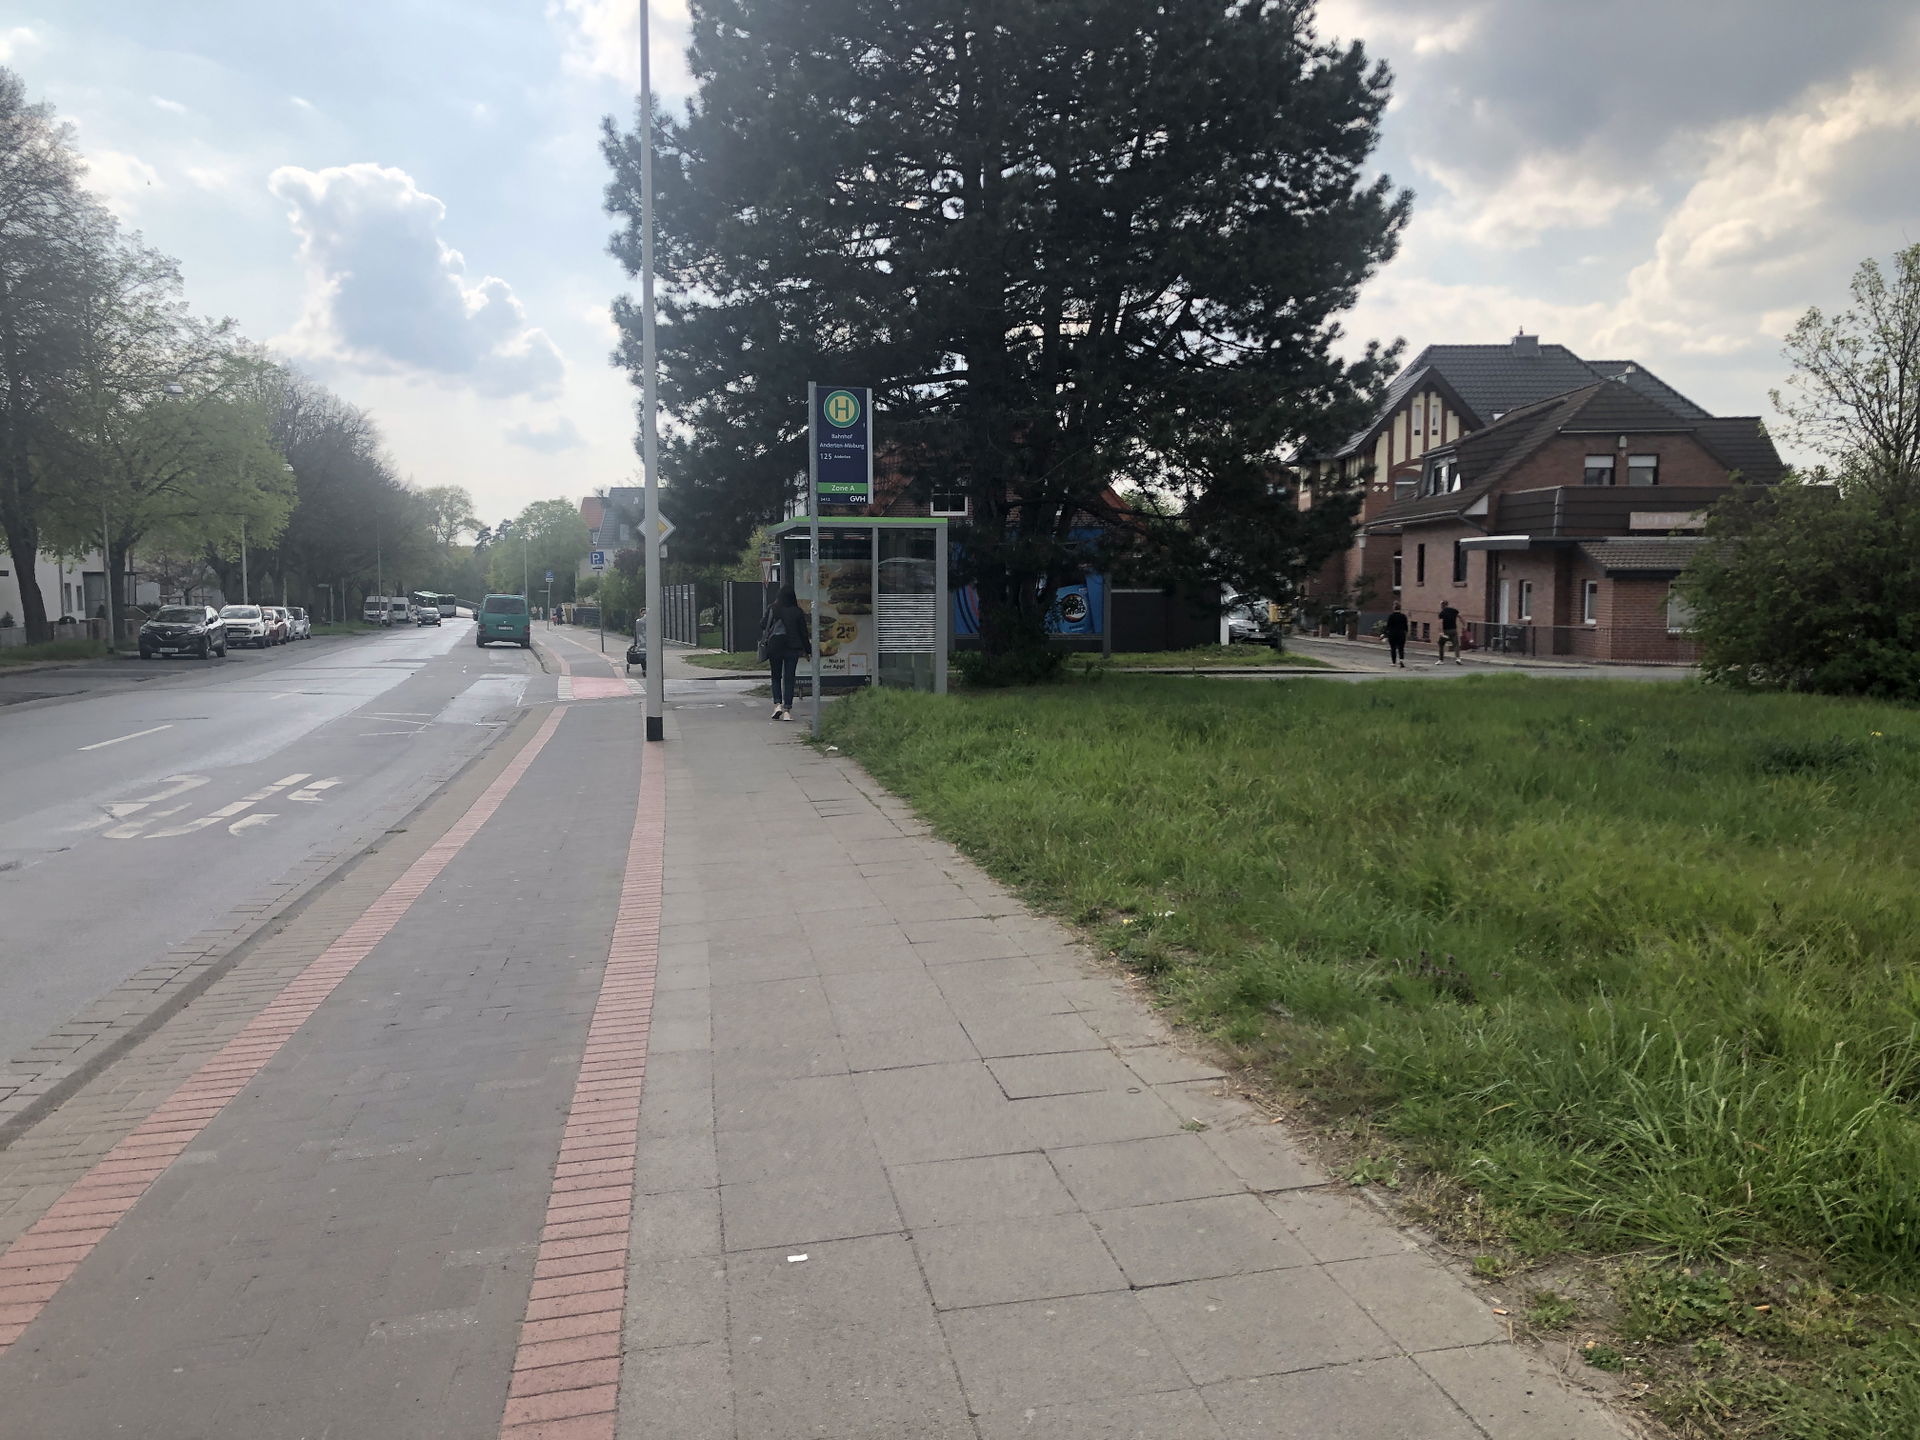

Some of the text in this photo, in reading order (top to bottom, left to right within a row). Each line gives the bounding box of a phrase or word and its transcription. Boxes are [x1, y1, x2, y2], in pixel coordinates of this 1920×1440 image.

[835, 399, 849, 419] H
[820, 452, 832, 460] 125
[592, 553, 600, 565] P
